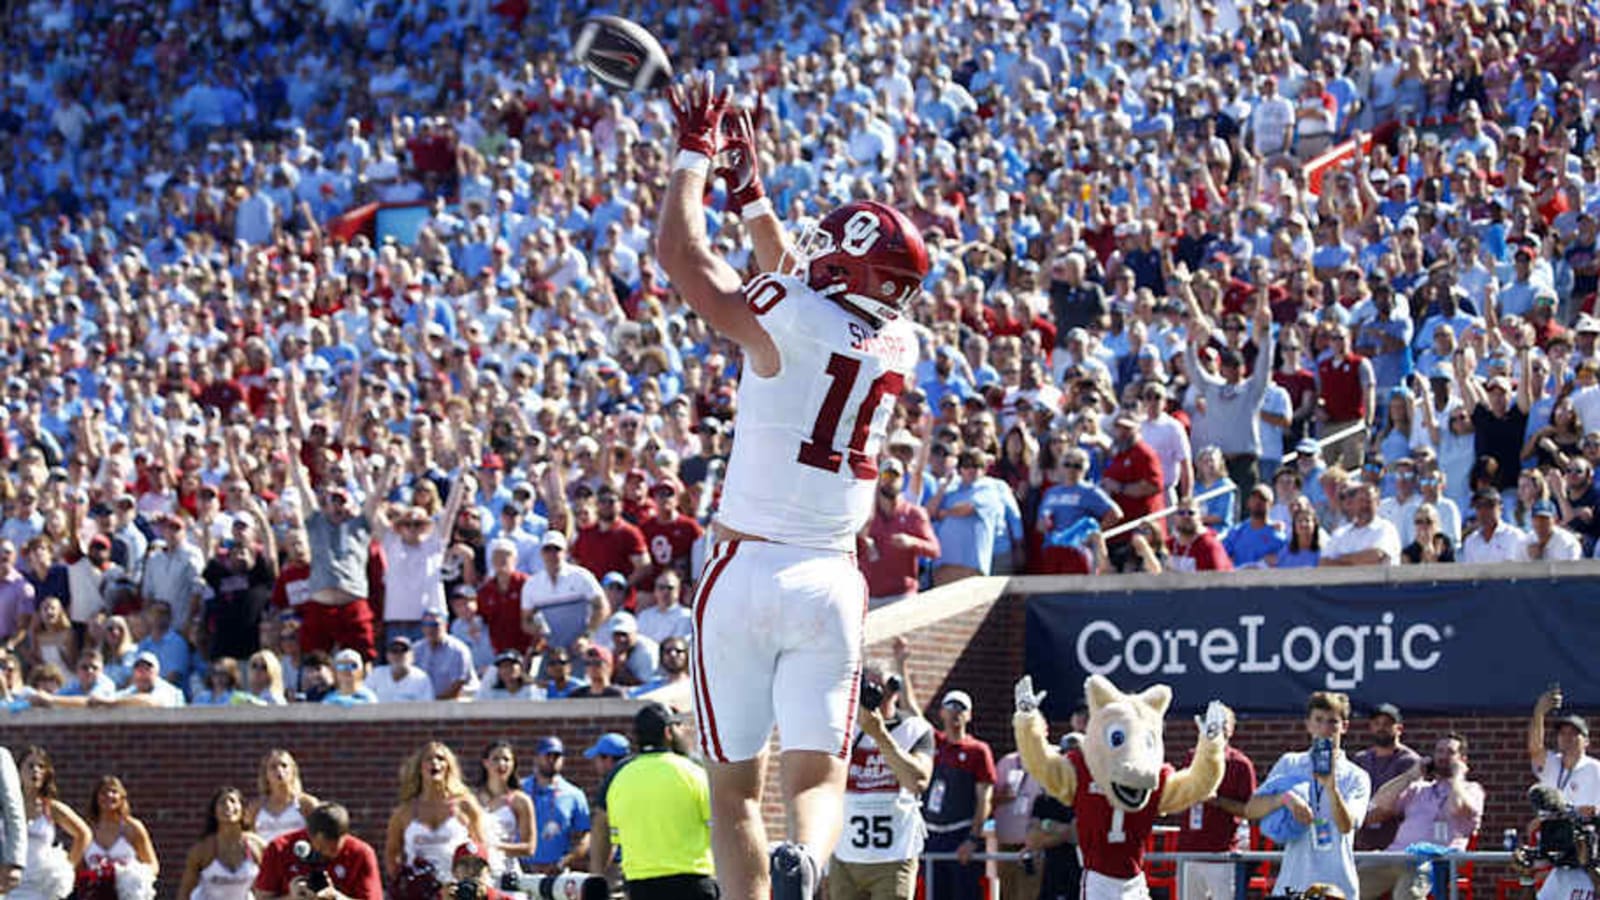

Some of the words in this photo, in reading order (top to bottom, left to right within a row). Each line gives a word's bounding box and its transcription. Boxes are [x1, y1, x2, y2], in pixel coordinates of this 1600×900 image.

[841, 210, 880, 257] OU
[1076, 611, 1442, 689] CoreLogic
[850, 815, 894, 849] 35
